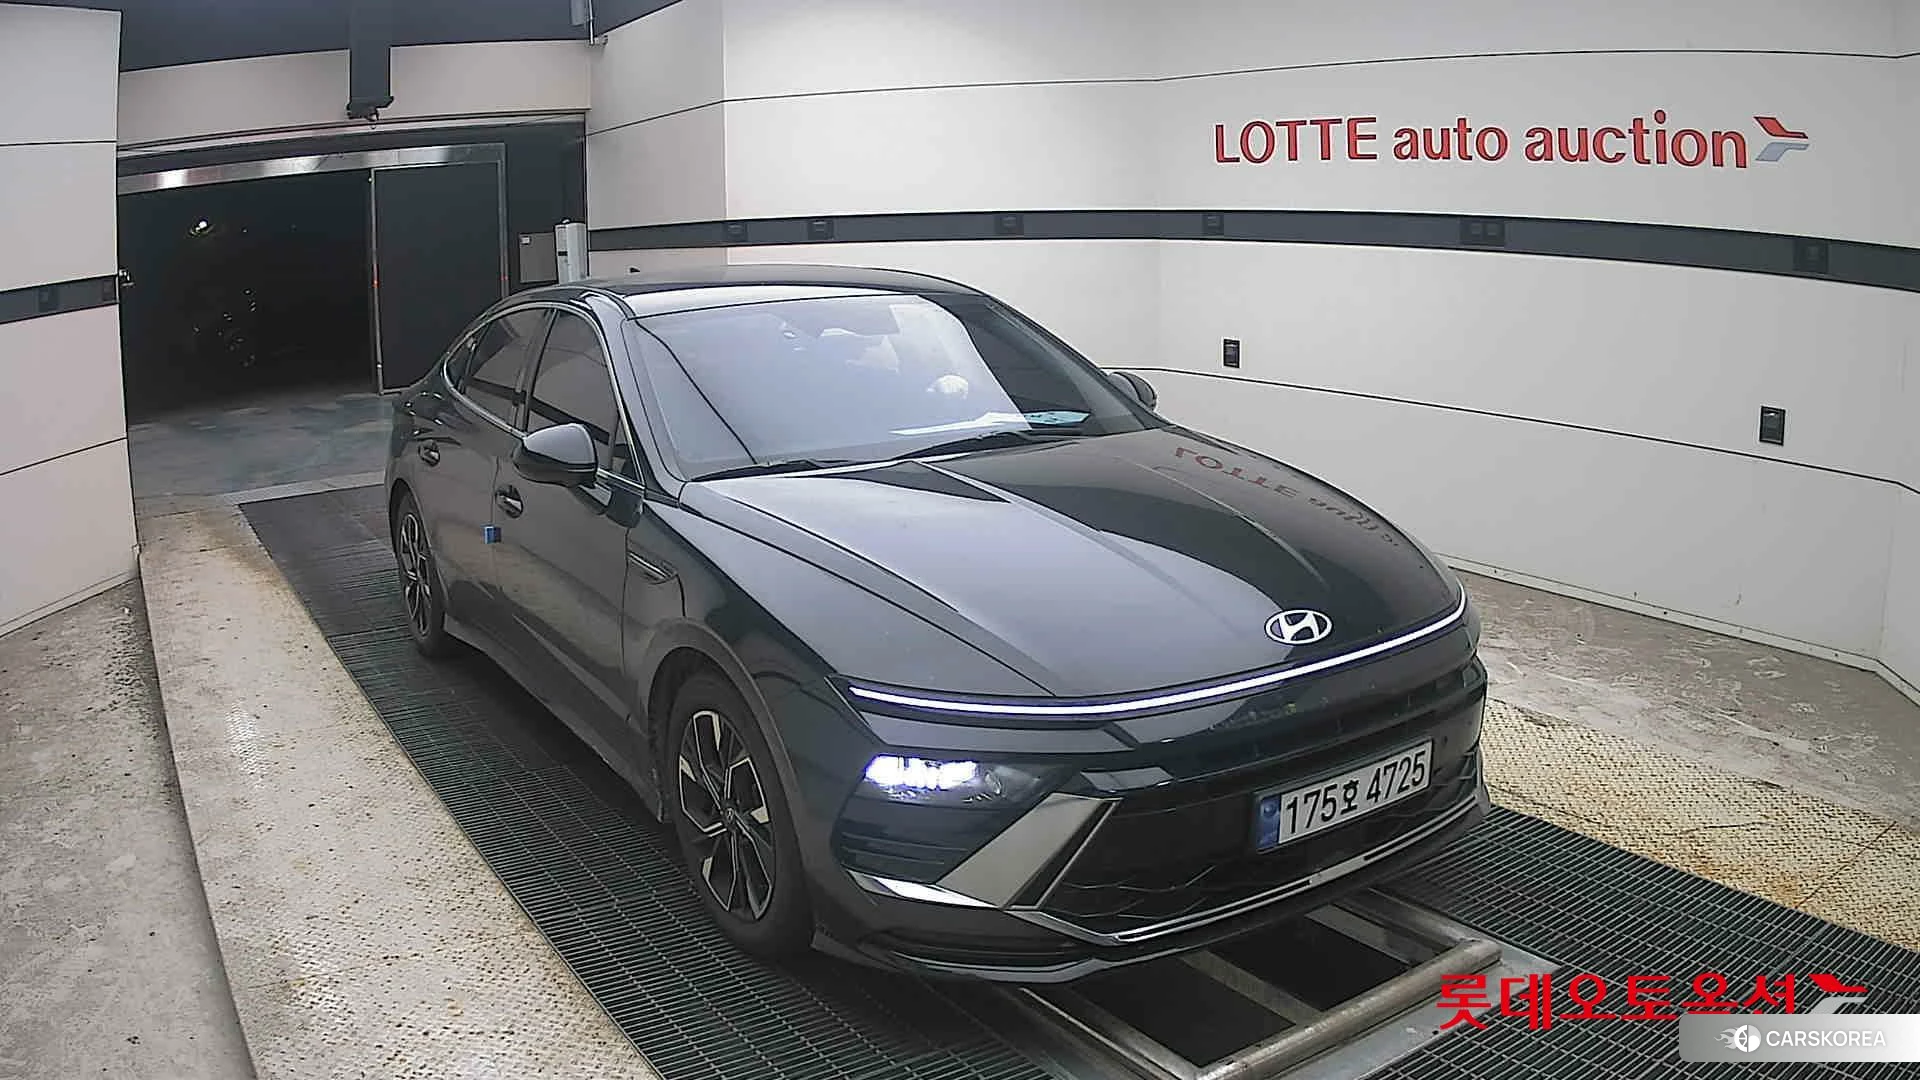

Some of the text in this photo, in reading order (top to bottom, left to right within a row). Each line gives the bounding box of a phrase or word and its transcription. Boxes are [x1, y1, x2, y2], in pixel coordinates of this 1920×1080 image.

[1215, 110, 1747, 168] LOTTE auto auction
[1285, 750, 1427, 835] 175호 4725
